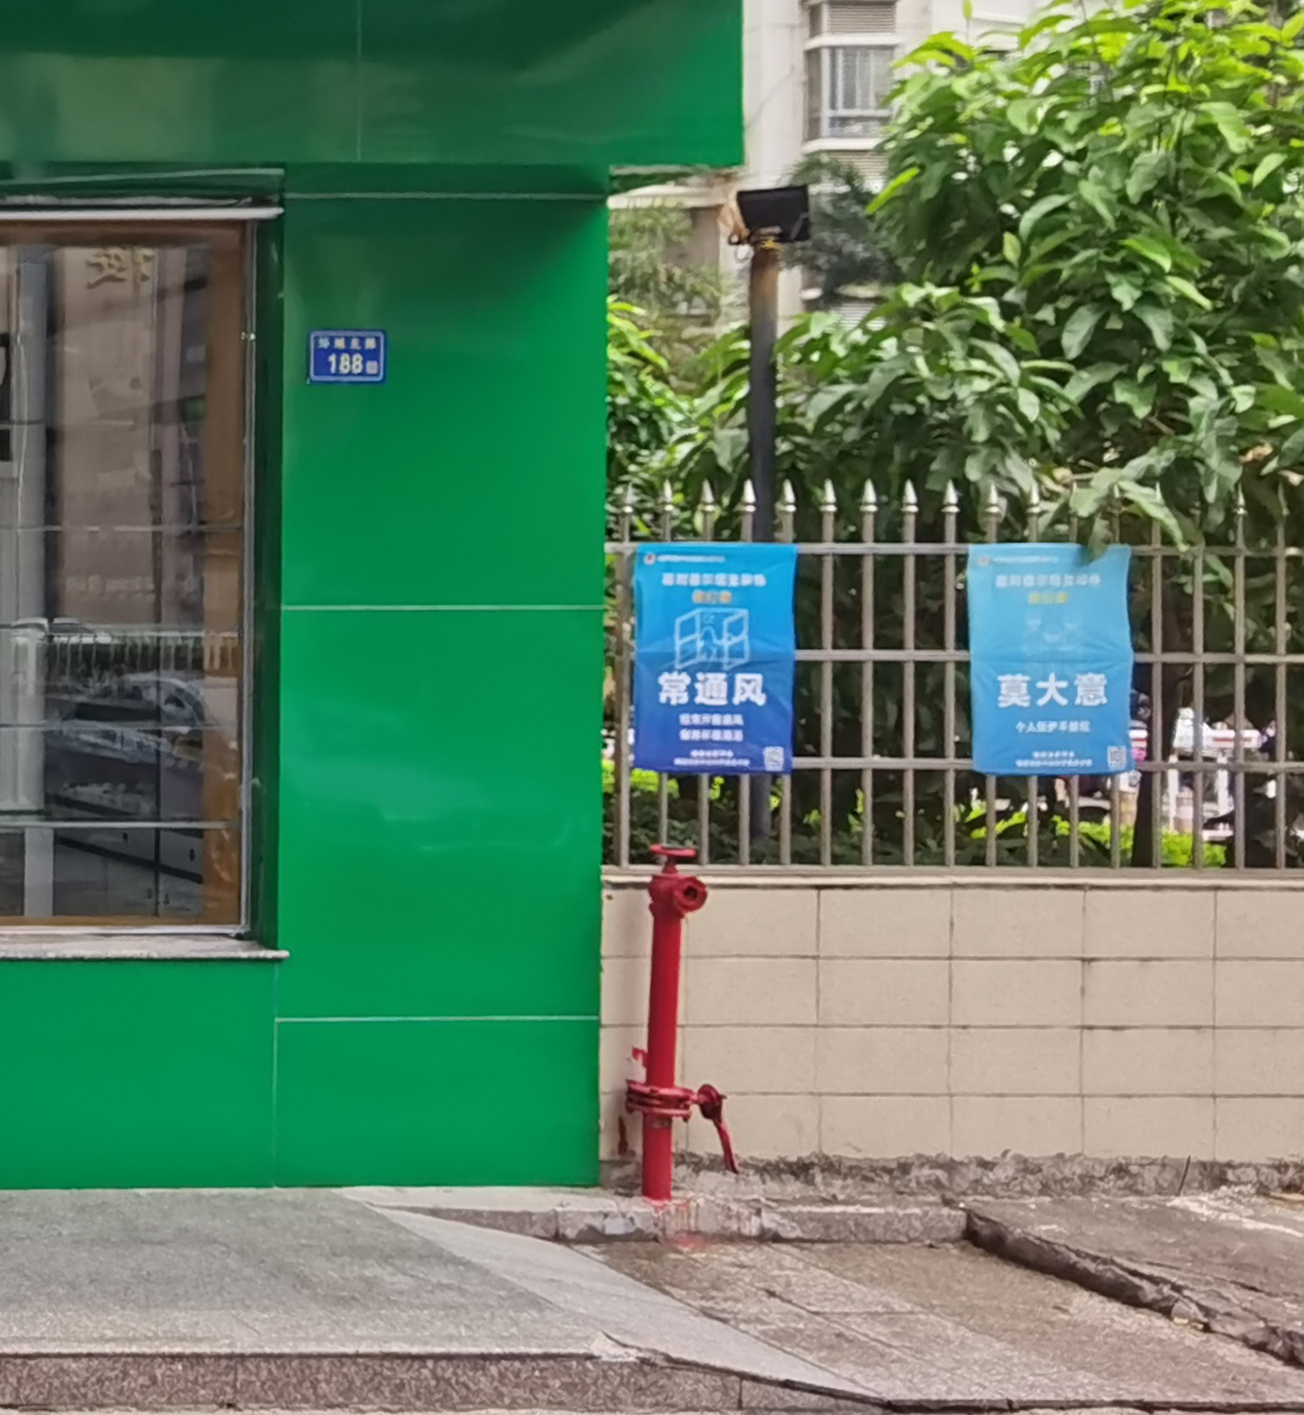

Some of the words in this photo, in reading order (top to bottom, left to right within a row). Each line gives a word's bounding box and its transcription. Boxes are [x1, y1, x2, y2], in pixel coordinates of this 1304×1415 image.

[658, 671, 767, 707] 常通风
[997, 673, 1108, 708] 莫大意
